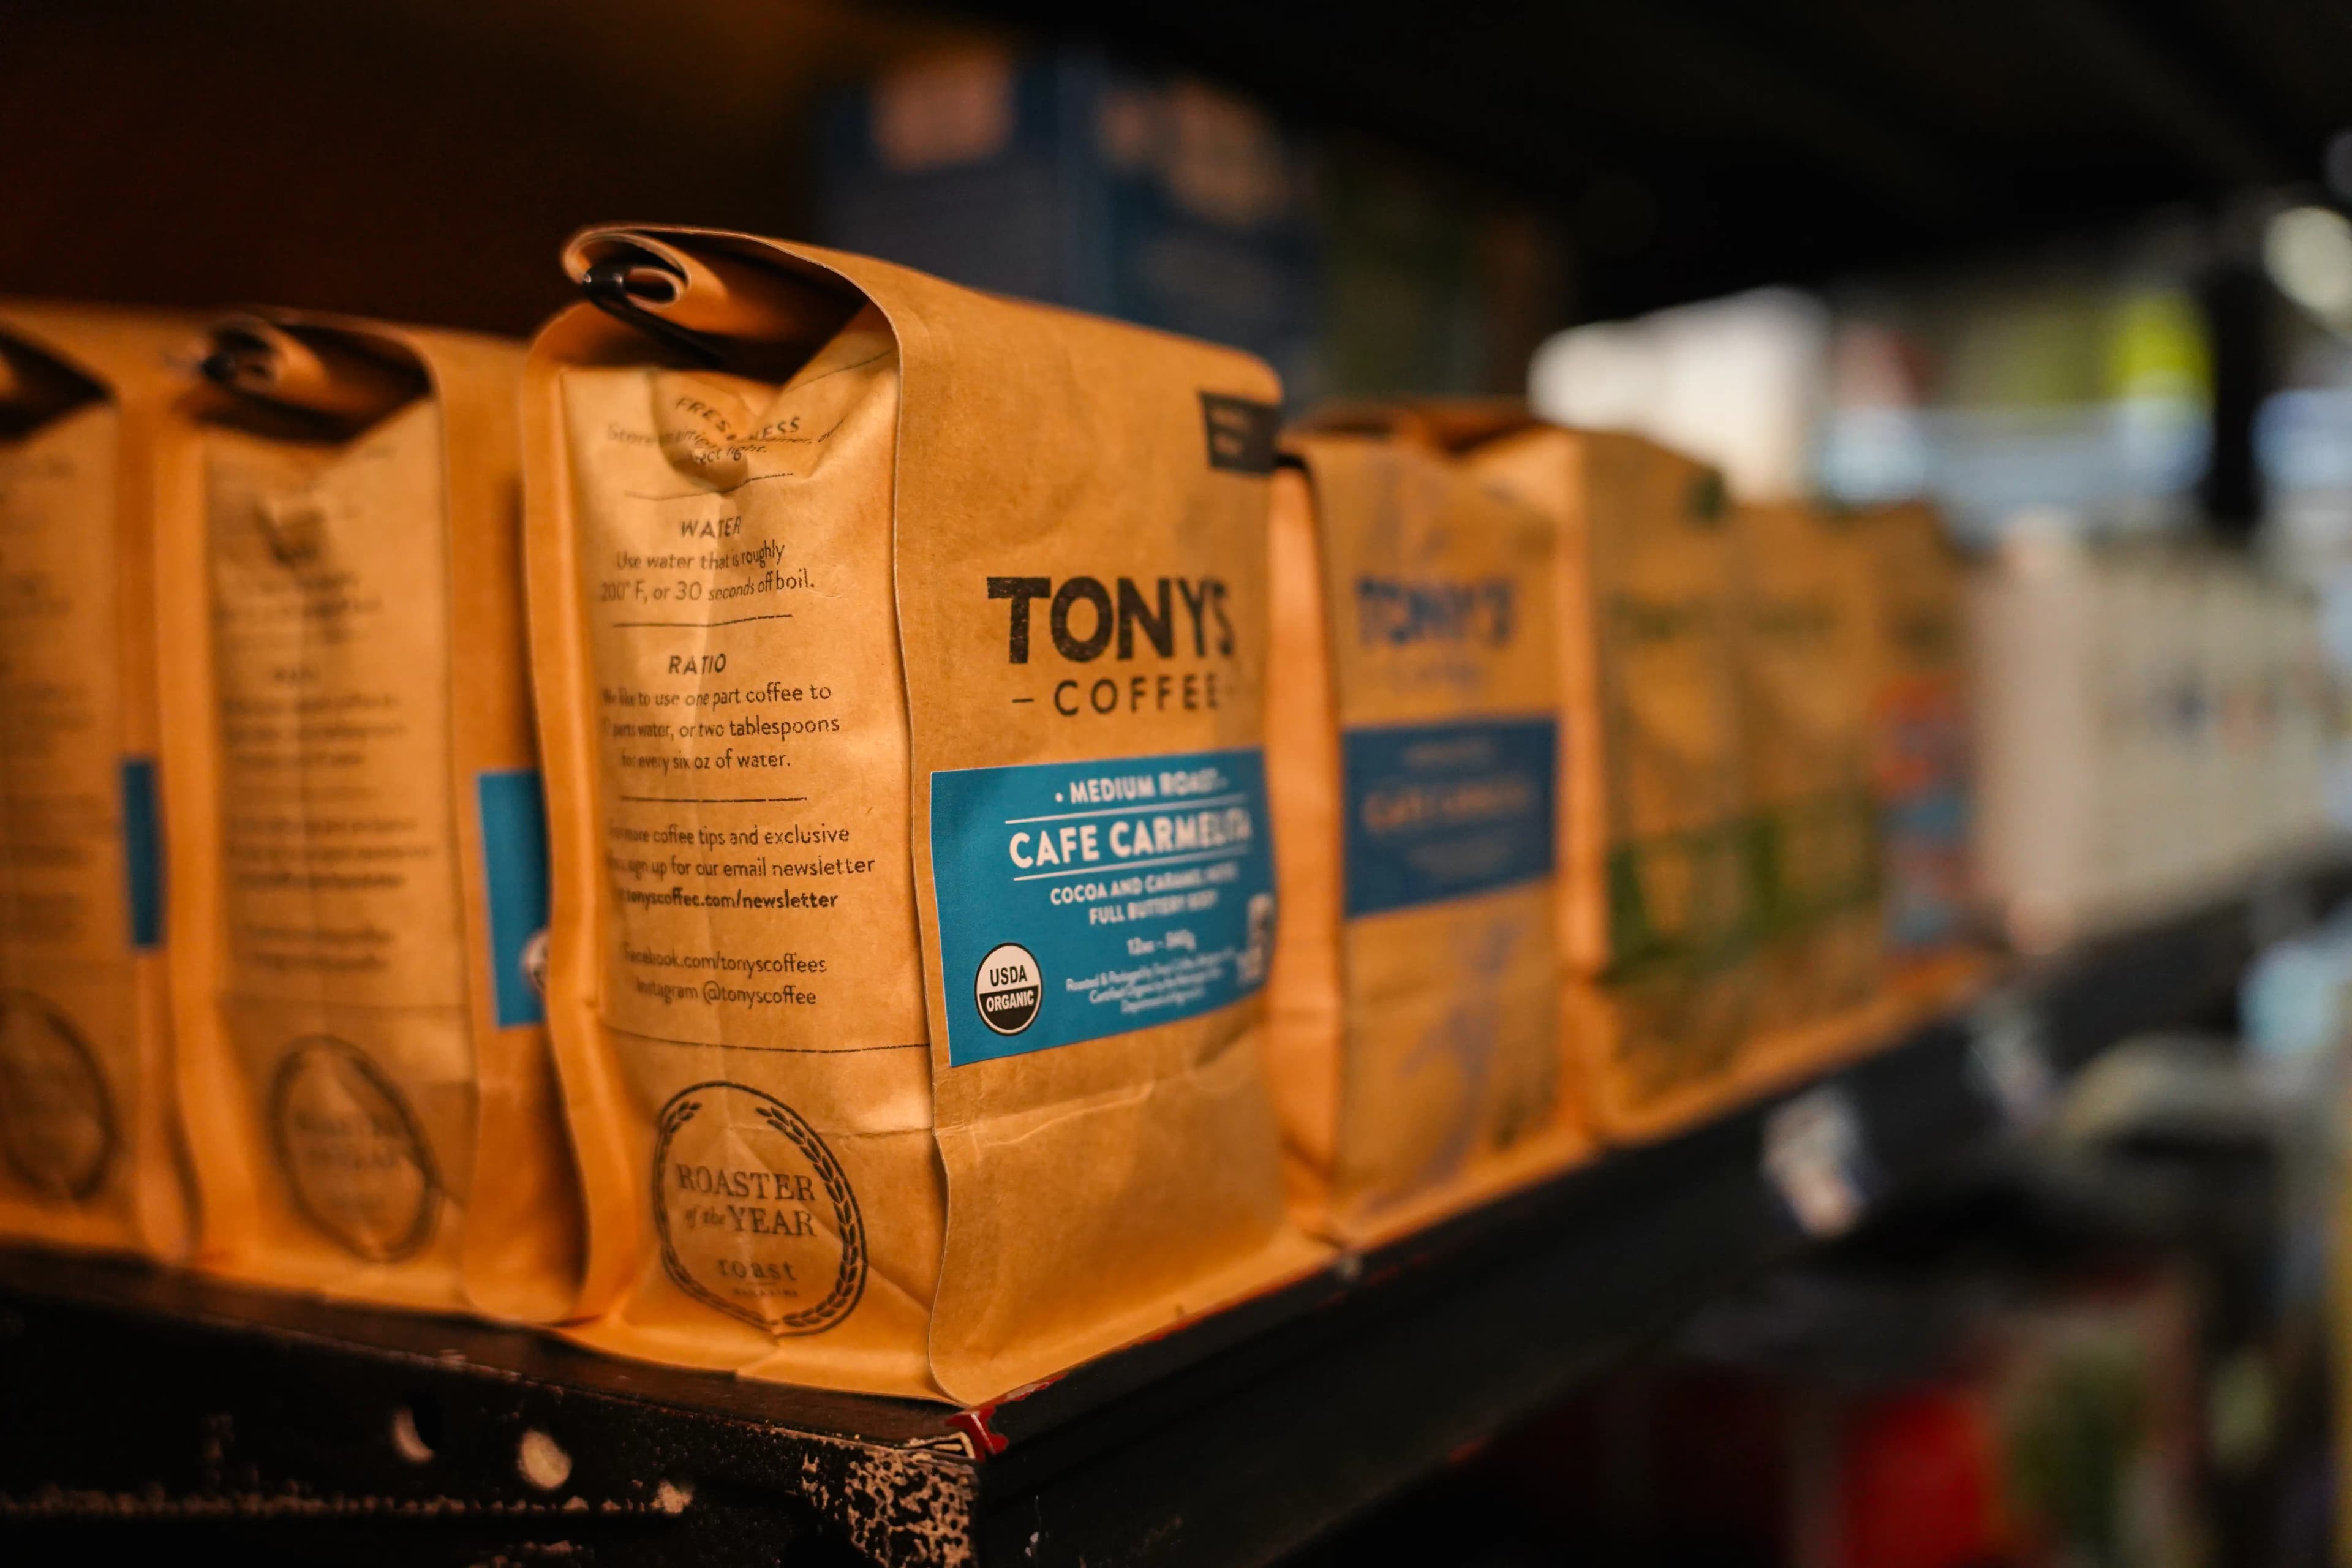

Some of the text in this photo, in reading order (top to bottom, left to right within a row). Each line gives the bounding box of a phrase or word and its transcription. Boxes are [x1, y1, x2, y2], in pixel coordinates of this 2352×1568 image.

[680, 516, 741, 538] WATER
[616, 539, 785, 570] Use water that is roughly
[654, 587, 671, 600] or
[675, 581, 703, 601] 30
[708, 578, 755, 601] seconds
[758, 570, 774, 592] off
[775, 568, 815, 590] boil.
[668, 652, 727, 674] RATIO
[638, 690, 651, 704] to
[655, 693, 680, 705] use
[685, 693, 709, 706] one
[712, 688, 741, 712] part
[745, 681, 802, 703] coffee
[809, 684, 831, 700] to
[679, 725, 695, 737] or
[699, 723, 725, 737] two
[729, 715, 840, 742] tablespoons
[638, 755, 670, 777] every
[673, 750, 691, 769] six
[694, 756, 711, 769] oz
[715, 748, 733, 769] of
[736, 753, 791, 768] water.
[1069, 774, 1156, 804] MEDIUM
[653, 823, 695, 845] coffee
[699, 826, 726, 853] tips
[729, 824, 758, 845] and
[764, 823, 850, 845] exclusive
[1009, 824, 1101, 869] CAFE
[652, 861, 668, 881] up
[671, 855, 692, 875] for
[696, 862, 719, 876] our
[723, 858, 767, 878] email
[772, 855, 876, 877] newsletter
[1050, 882, 1108, 906] COCOA
[1110, 877, 1143, 897] AND
[1088, 905, 1126, 925] FULL
[990, 964, 1028, 987] USDA
[702, 981, 817, 1010] @tonyscoffee
[986, 989, 1035, 1014] ORGANIC
[676, 1163, 816, 1201] ROASTER
[726, 1204, 818, 1236] YEAR
[717, 1259, 799, 1281] roast
